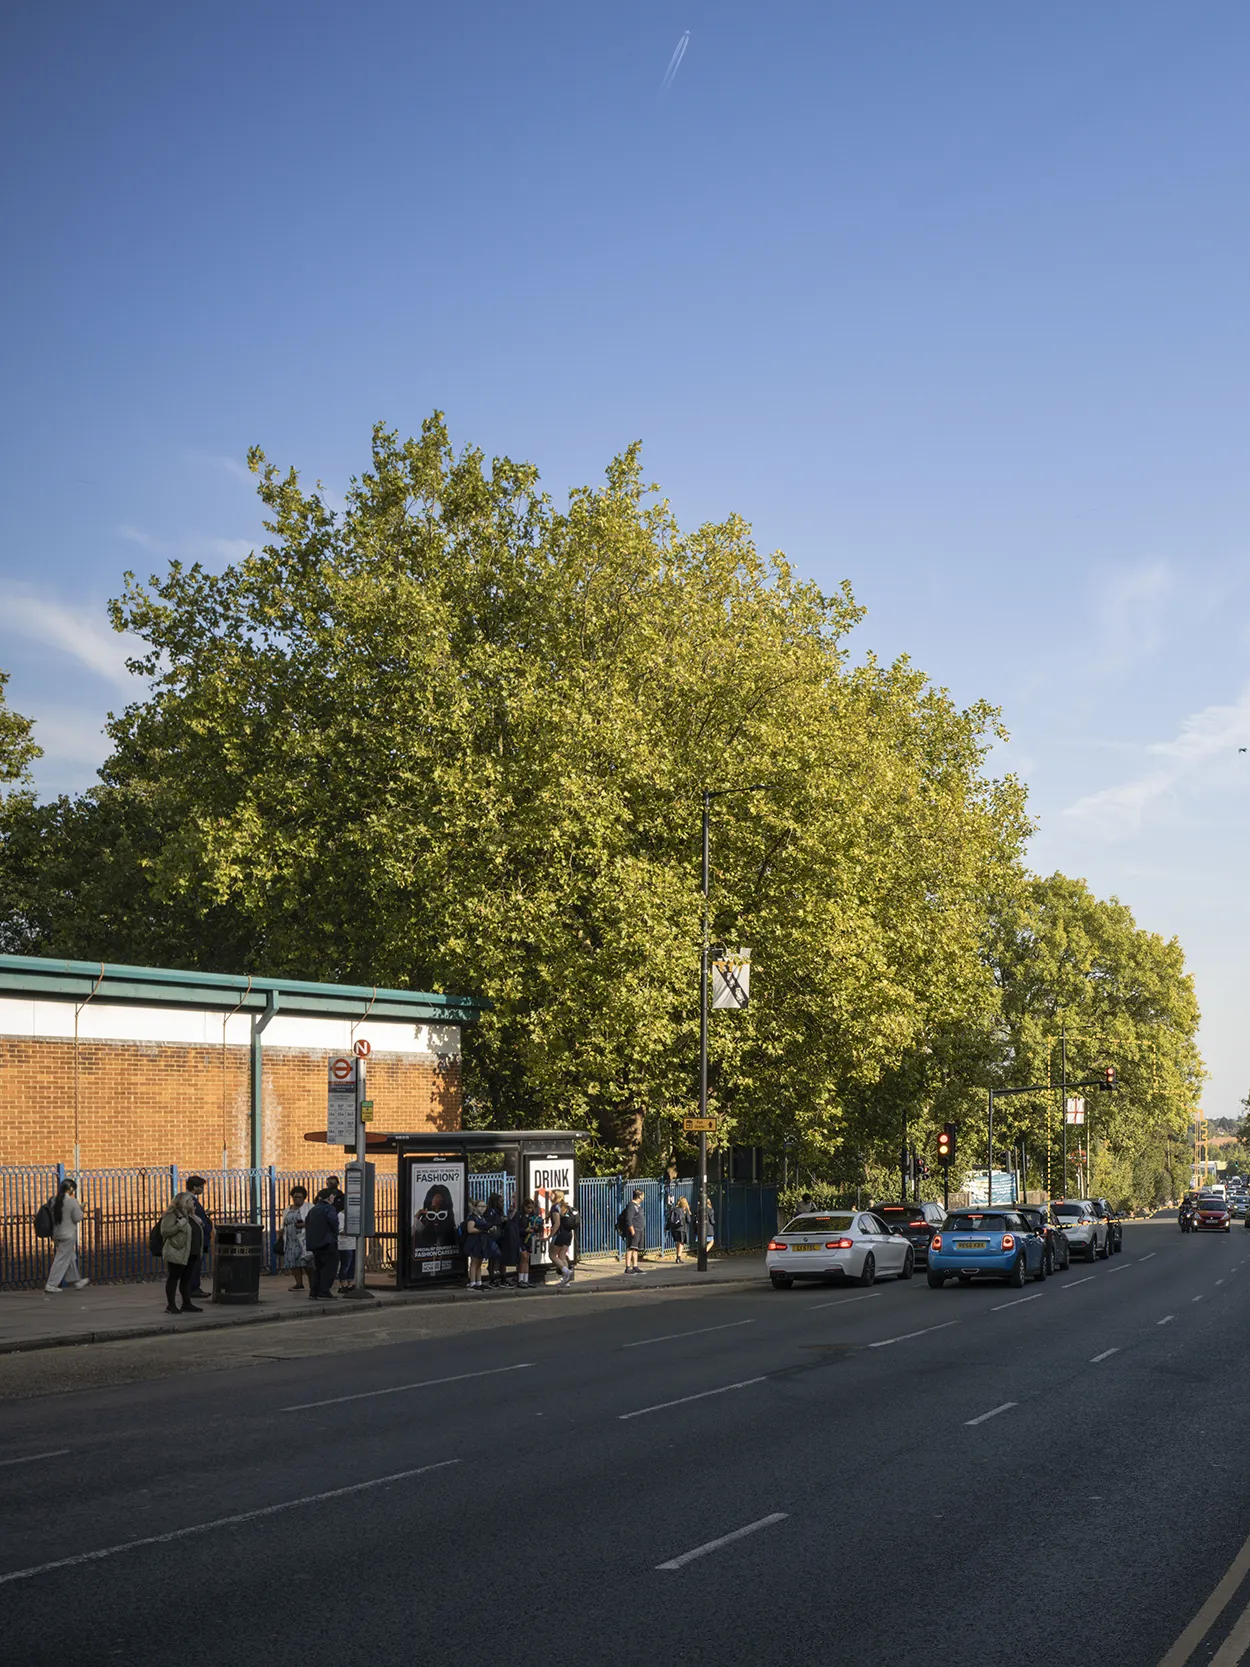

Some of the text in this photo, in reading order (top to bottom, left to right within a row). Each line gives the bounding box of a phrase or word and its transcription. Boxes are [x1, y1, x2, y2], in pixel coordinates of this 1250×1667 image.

[355, 1041, 368, 1054] N
[416, 1173, 460, 1183] FASHION?
[534, 1168, 570, 1189] DRINK
